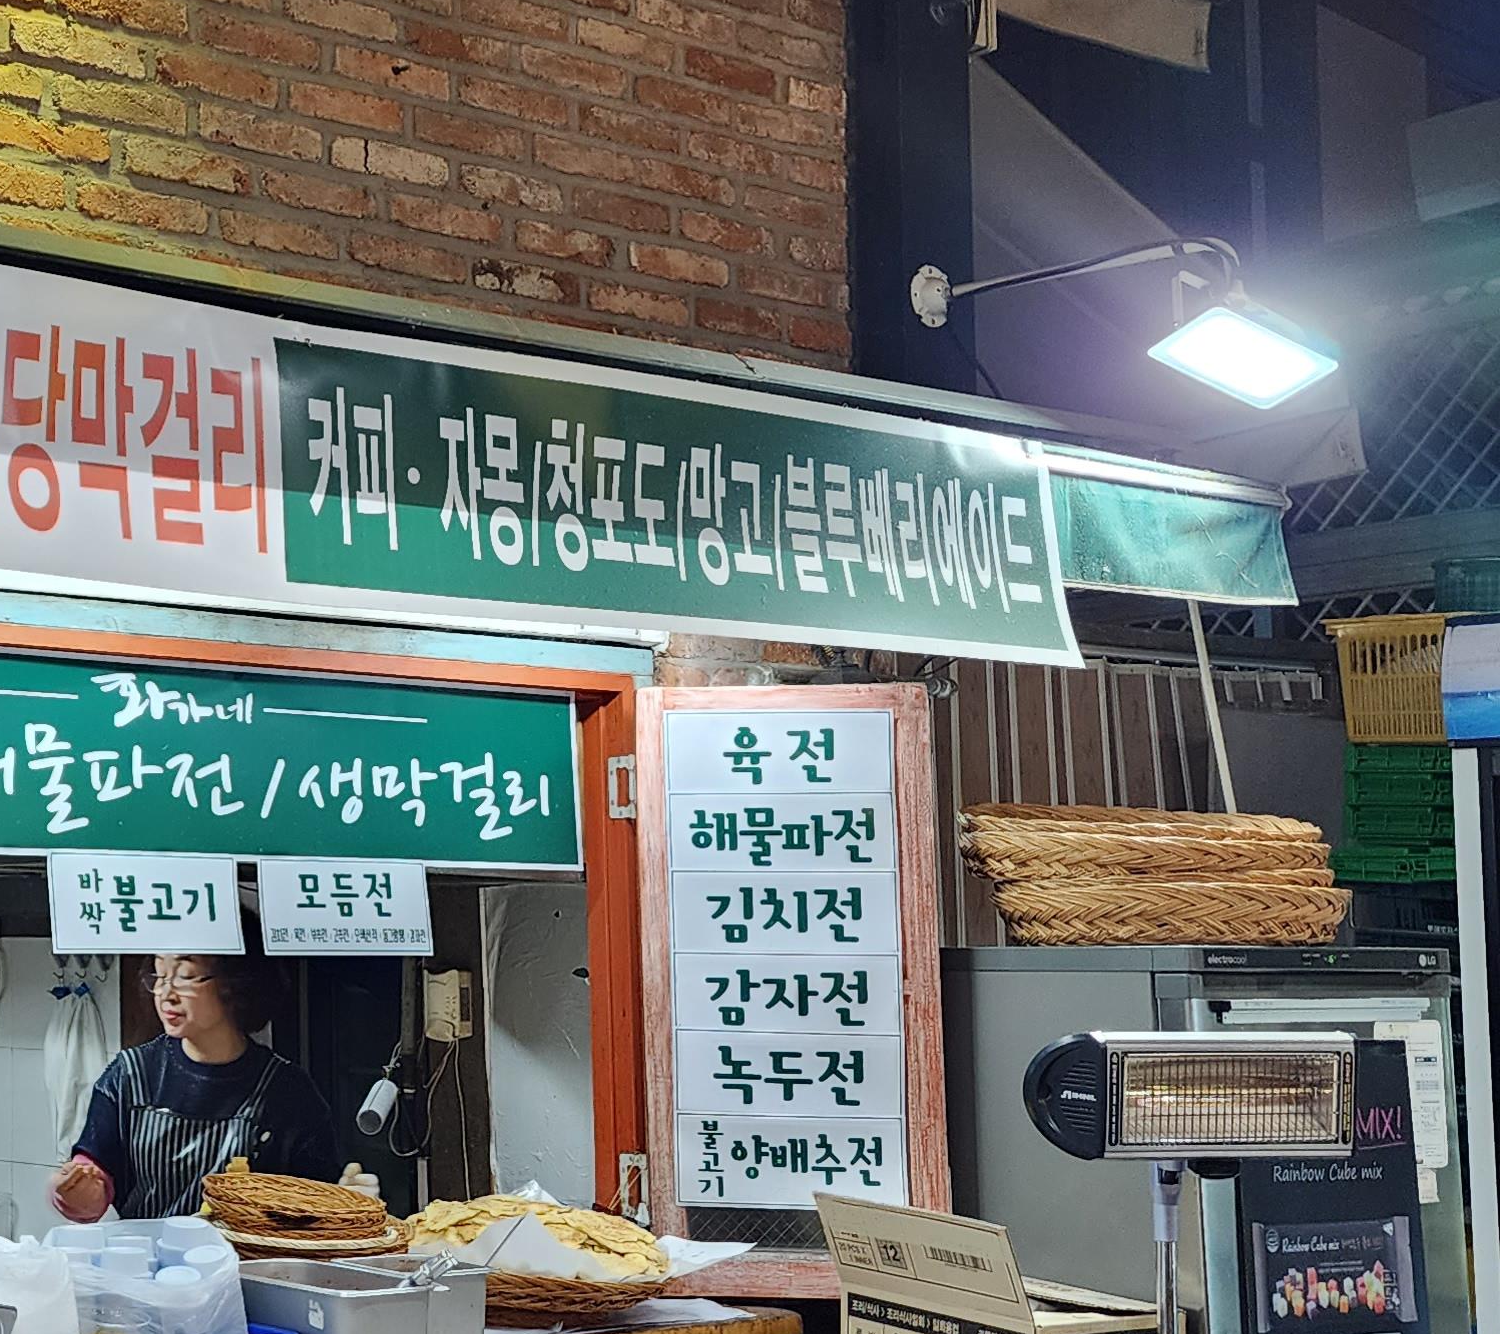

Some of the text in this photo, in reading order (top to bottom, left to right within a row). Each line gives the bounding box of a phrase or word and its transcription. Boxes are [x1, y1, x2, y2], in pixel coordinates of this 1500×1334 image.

[300, 752, 551, 840] 생막걸리
[689, 807, 875, 866] 해물파전
[110, 875, 217, 932] 불고기
[297, 873, 393, 917] 모듬전
[706, 887, 862, 943] 김치전
[705, 969, 869, 1027] 감자전
[713, 1046, 865, 1106] 녹두전
[698, 1120, 884, 1197] 불고기 양배추전
[1273, 1162, 1384, 1182] Rainbow Cube mix
[883, 1244, 901, 1263] 12
